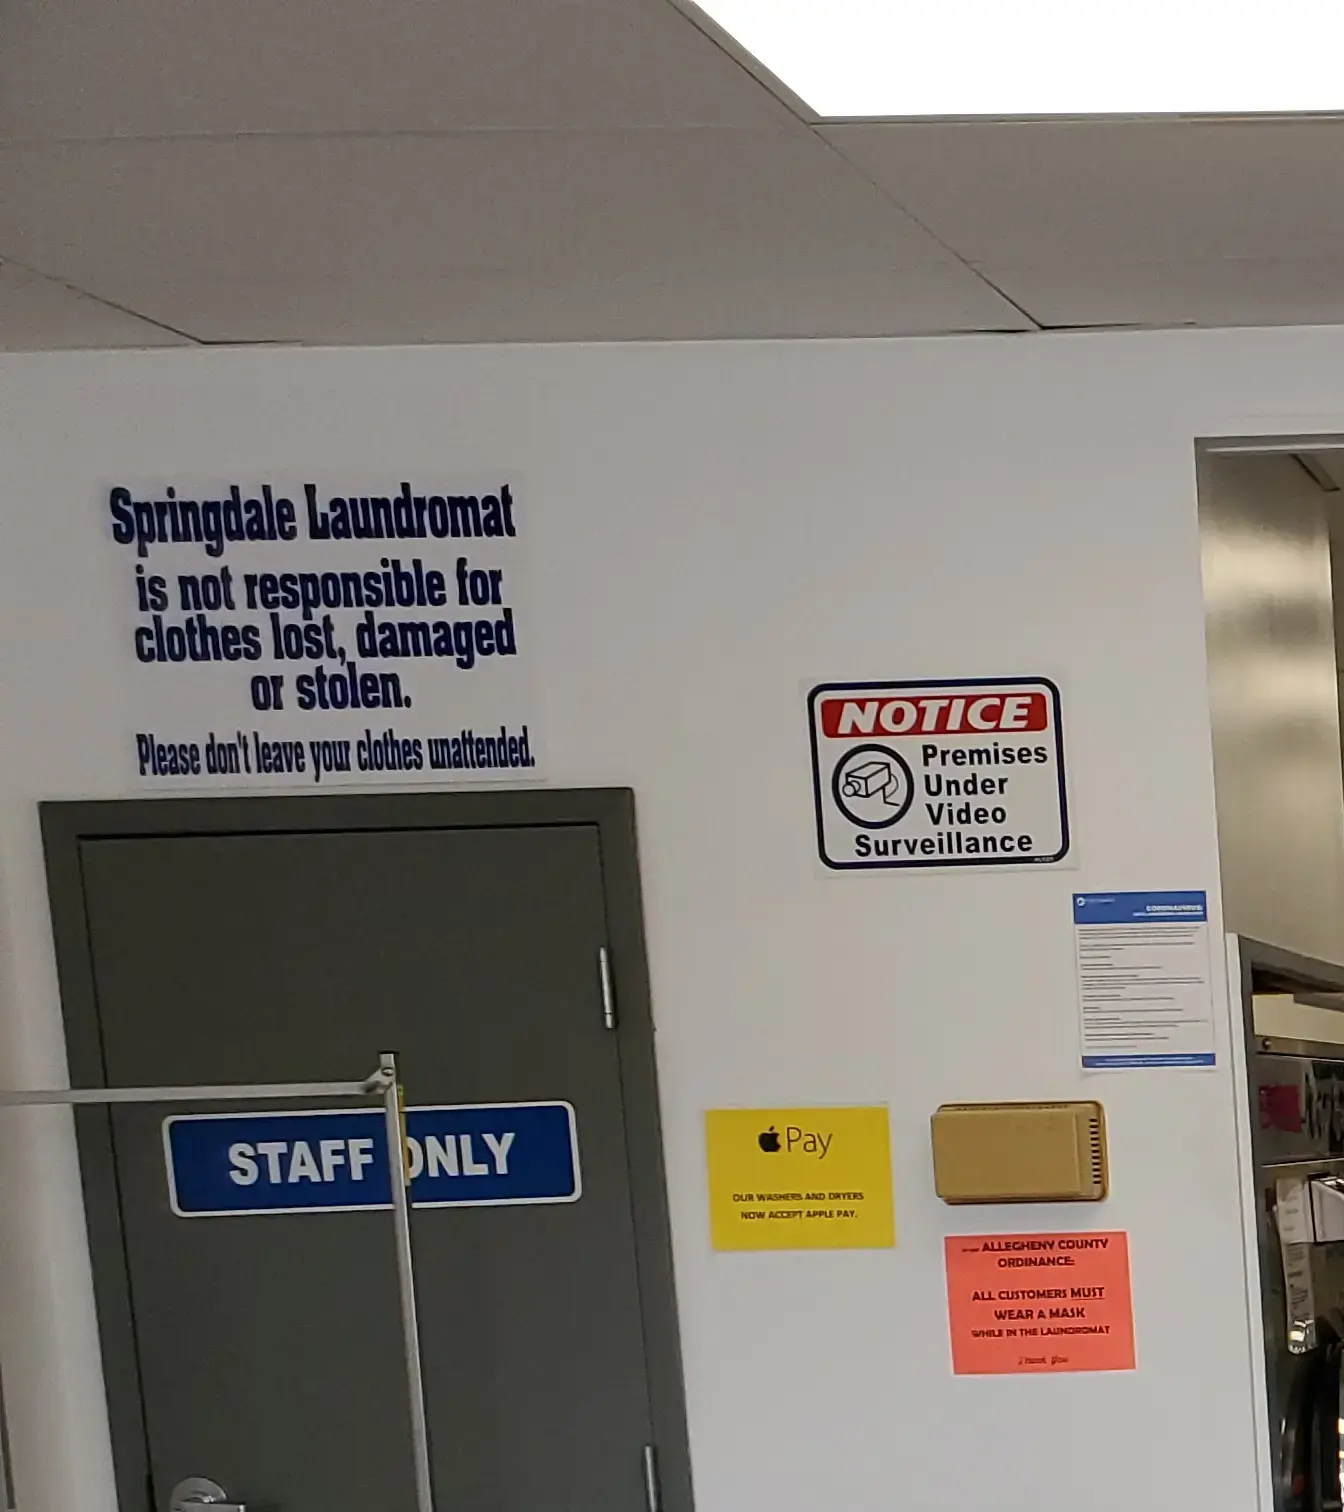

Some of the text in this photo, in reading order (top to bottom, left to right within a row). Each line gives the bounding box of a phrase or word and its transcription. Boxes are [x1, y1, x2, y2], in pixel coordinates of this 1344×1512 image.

[110, 482, 517, 557] Springdale Laundromat
[135, 557, 503, 618] is not responsible for
[135, 608, 517, 669] clothes lost, damaged
[250, 662, 411, 711] or stolen.
[837, 696, 1032, 734] NOTICE
[136, 726, 536, 782] Please don't leave your clothes unattended.
[922, 742, 1048, 767] Premises
[924, 773, 1008, 797] Under
[925, 802, 1007, 825] Video
[855, 832, 1033, 857] Surveillance
[786, 1126, 834, 1160] Pay
[227, 1138, 374, 1186] STAFF
[732, 1191, 865, 1204] OUR WASHERS AND DRYERS
[740, 1208, 858, 1220] NOW ACCEPT APPLE PAY.
[981, 1239, 1055, 1252] ALLEGHENY
[1057, 1238, 1109, 1251] COUNTY
[997, 1255, 1075, 1268] ORDINANCE:
[972, 1285, 1105, 1302] ALL CUSTOMERS MUST
[994, 1307, 1086, 1321] WEAR A MASK
[971, 1325, 1110, 1339] WHILE IN THE LAUNDROMAT
